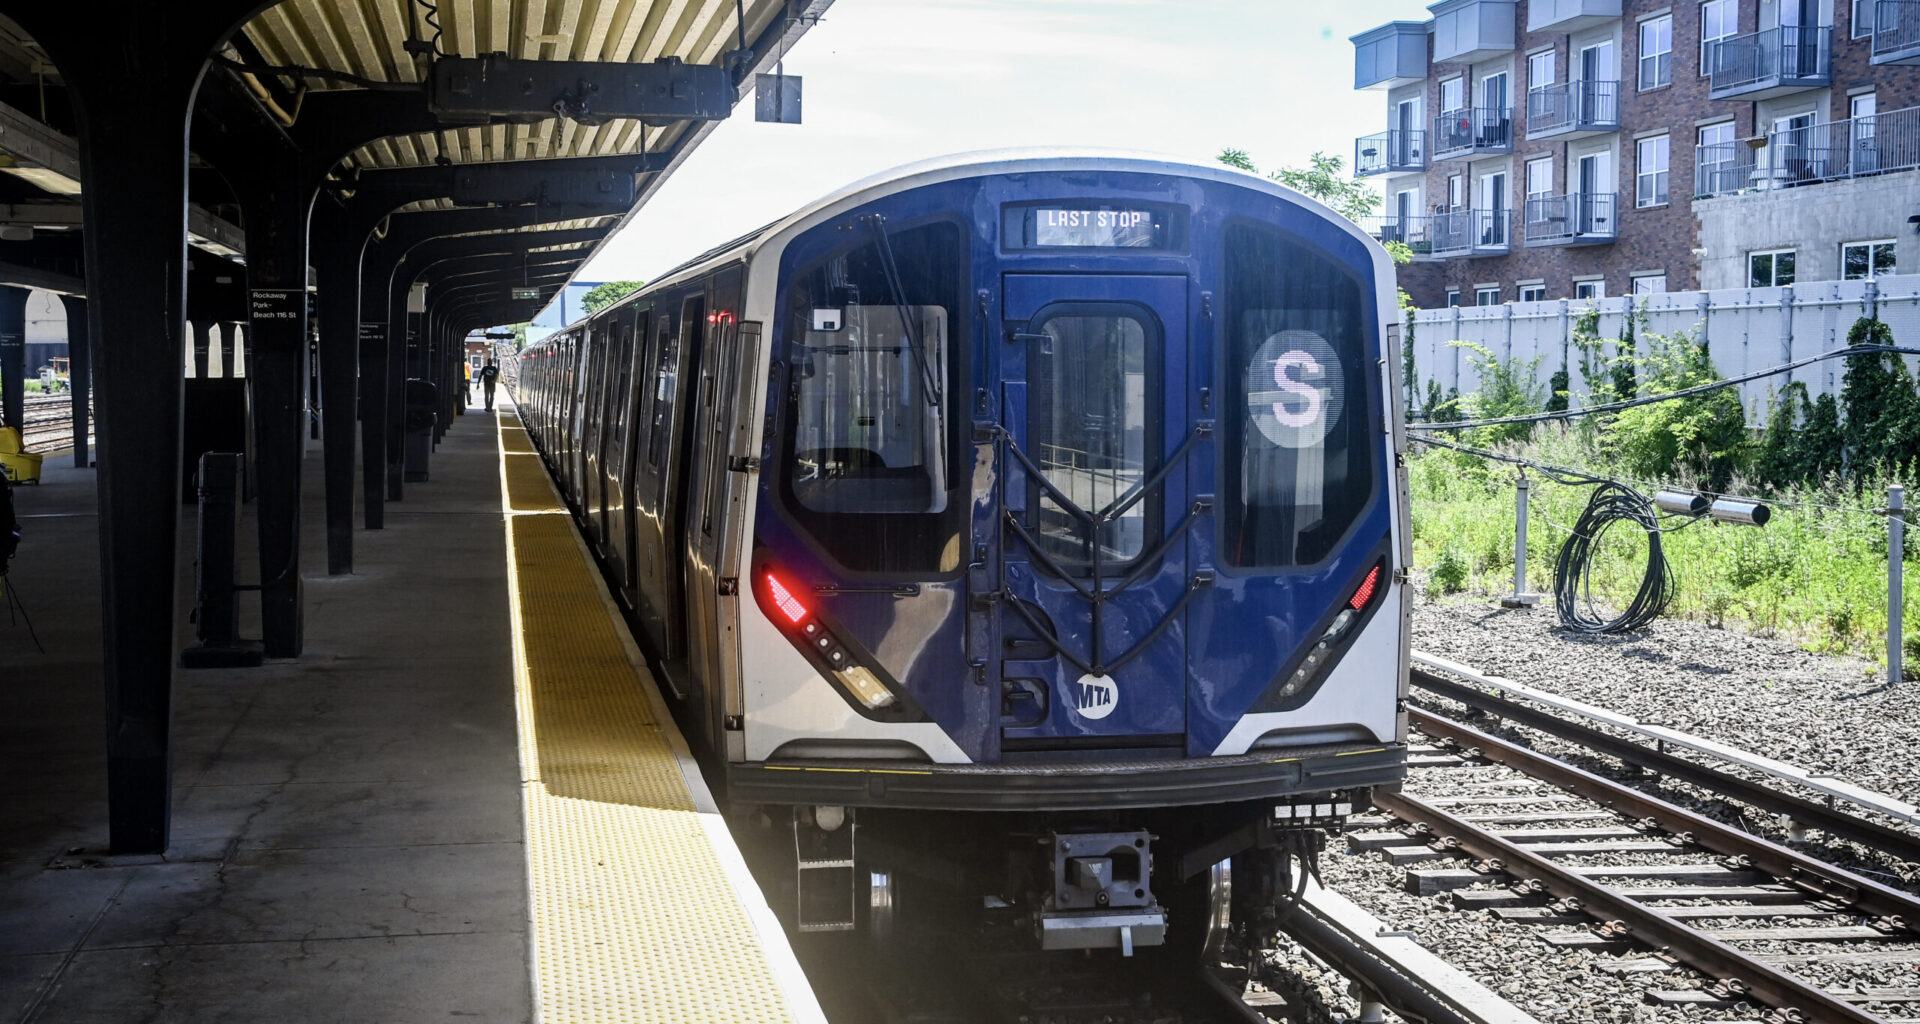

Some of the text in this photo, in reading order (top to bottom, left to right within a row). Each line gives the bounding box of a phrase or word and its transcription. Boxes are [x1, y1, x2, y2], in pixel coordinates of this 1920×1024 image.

[1049, 211, 1141, 227] LAST STOP
[253, 292, 287, 300] Rockaway
[1273, 350, 1320, 428] S
[1076, 683, 1111, 710] MTA
